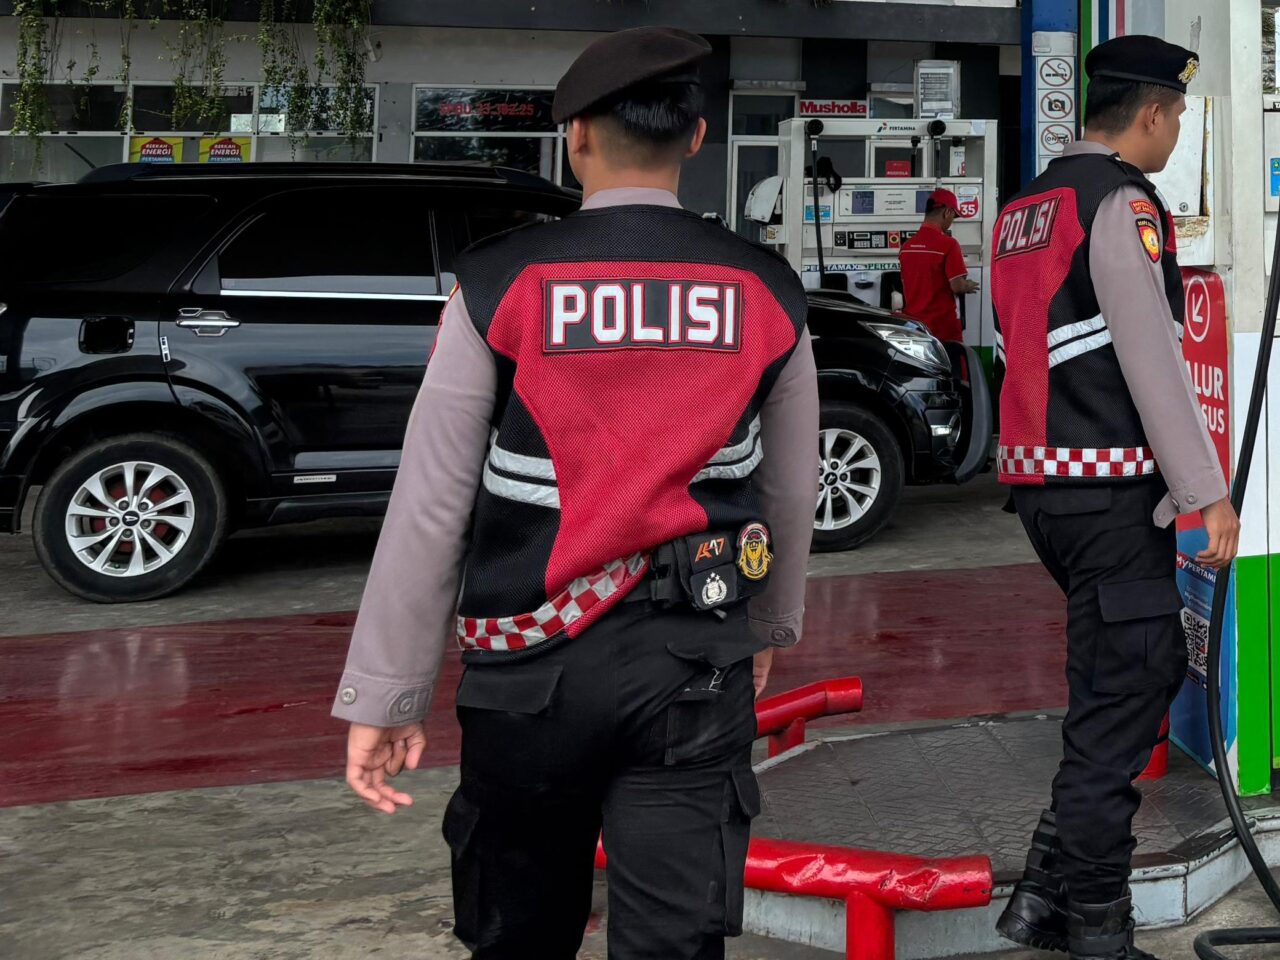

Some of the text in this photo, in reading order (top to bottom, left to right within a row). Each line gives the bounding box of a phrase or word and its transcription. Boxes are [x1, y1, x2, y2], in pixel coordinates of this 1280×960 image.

[800, 101, 867, 115] Musholla
[960, 204, 976, 216] 35
[996, 199, 1056, 256] POLISI
[550, 283, 736, 346] POLISI
[1185, 360, 1224, 401] ALUR
[1201, 404, 1225, 435] SUS
